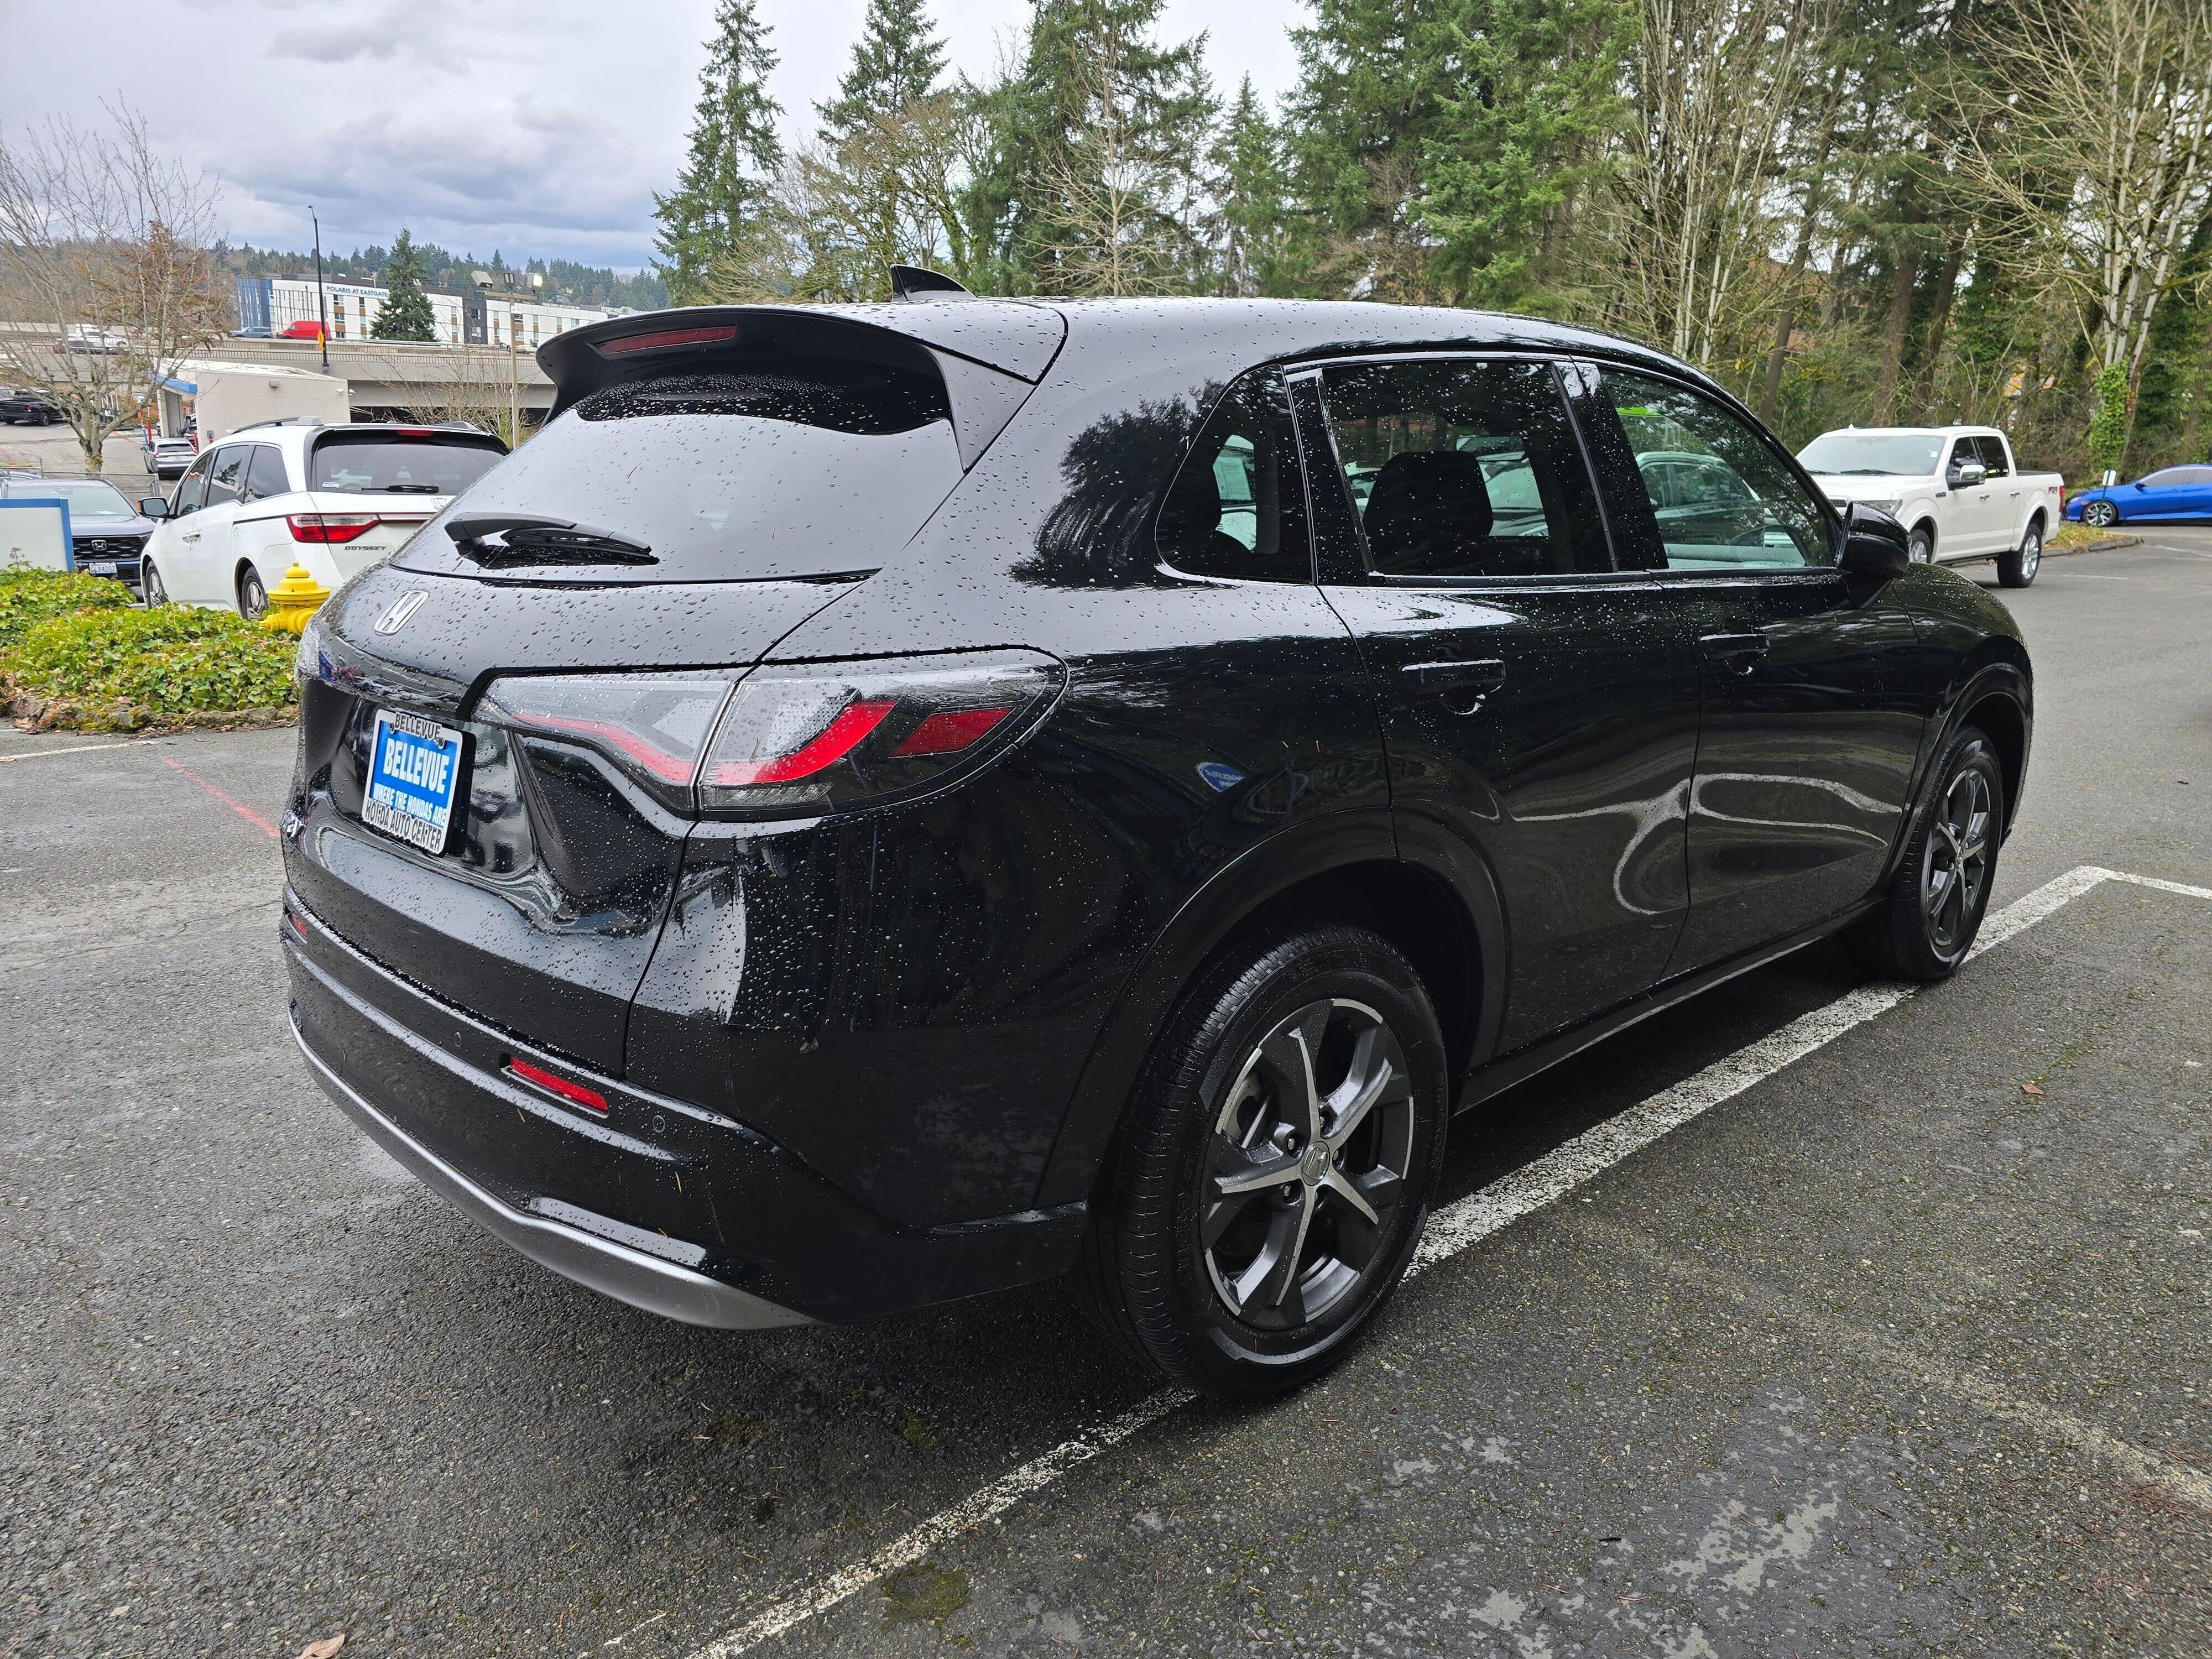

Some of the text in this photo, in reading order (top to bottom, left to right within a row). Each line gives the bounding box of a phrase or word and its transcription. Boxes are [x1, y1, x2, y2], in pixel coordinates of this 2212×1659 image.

[395, 713, 441, 741] BELLEVUE
[383, 738, 450, 794] BELLEVUE
[365, 800, 442, 849] HONDA AUTO CENTER
[373, 782, 447, 825] WHERE THE HONDAS ARE
